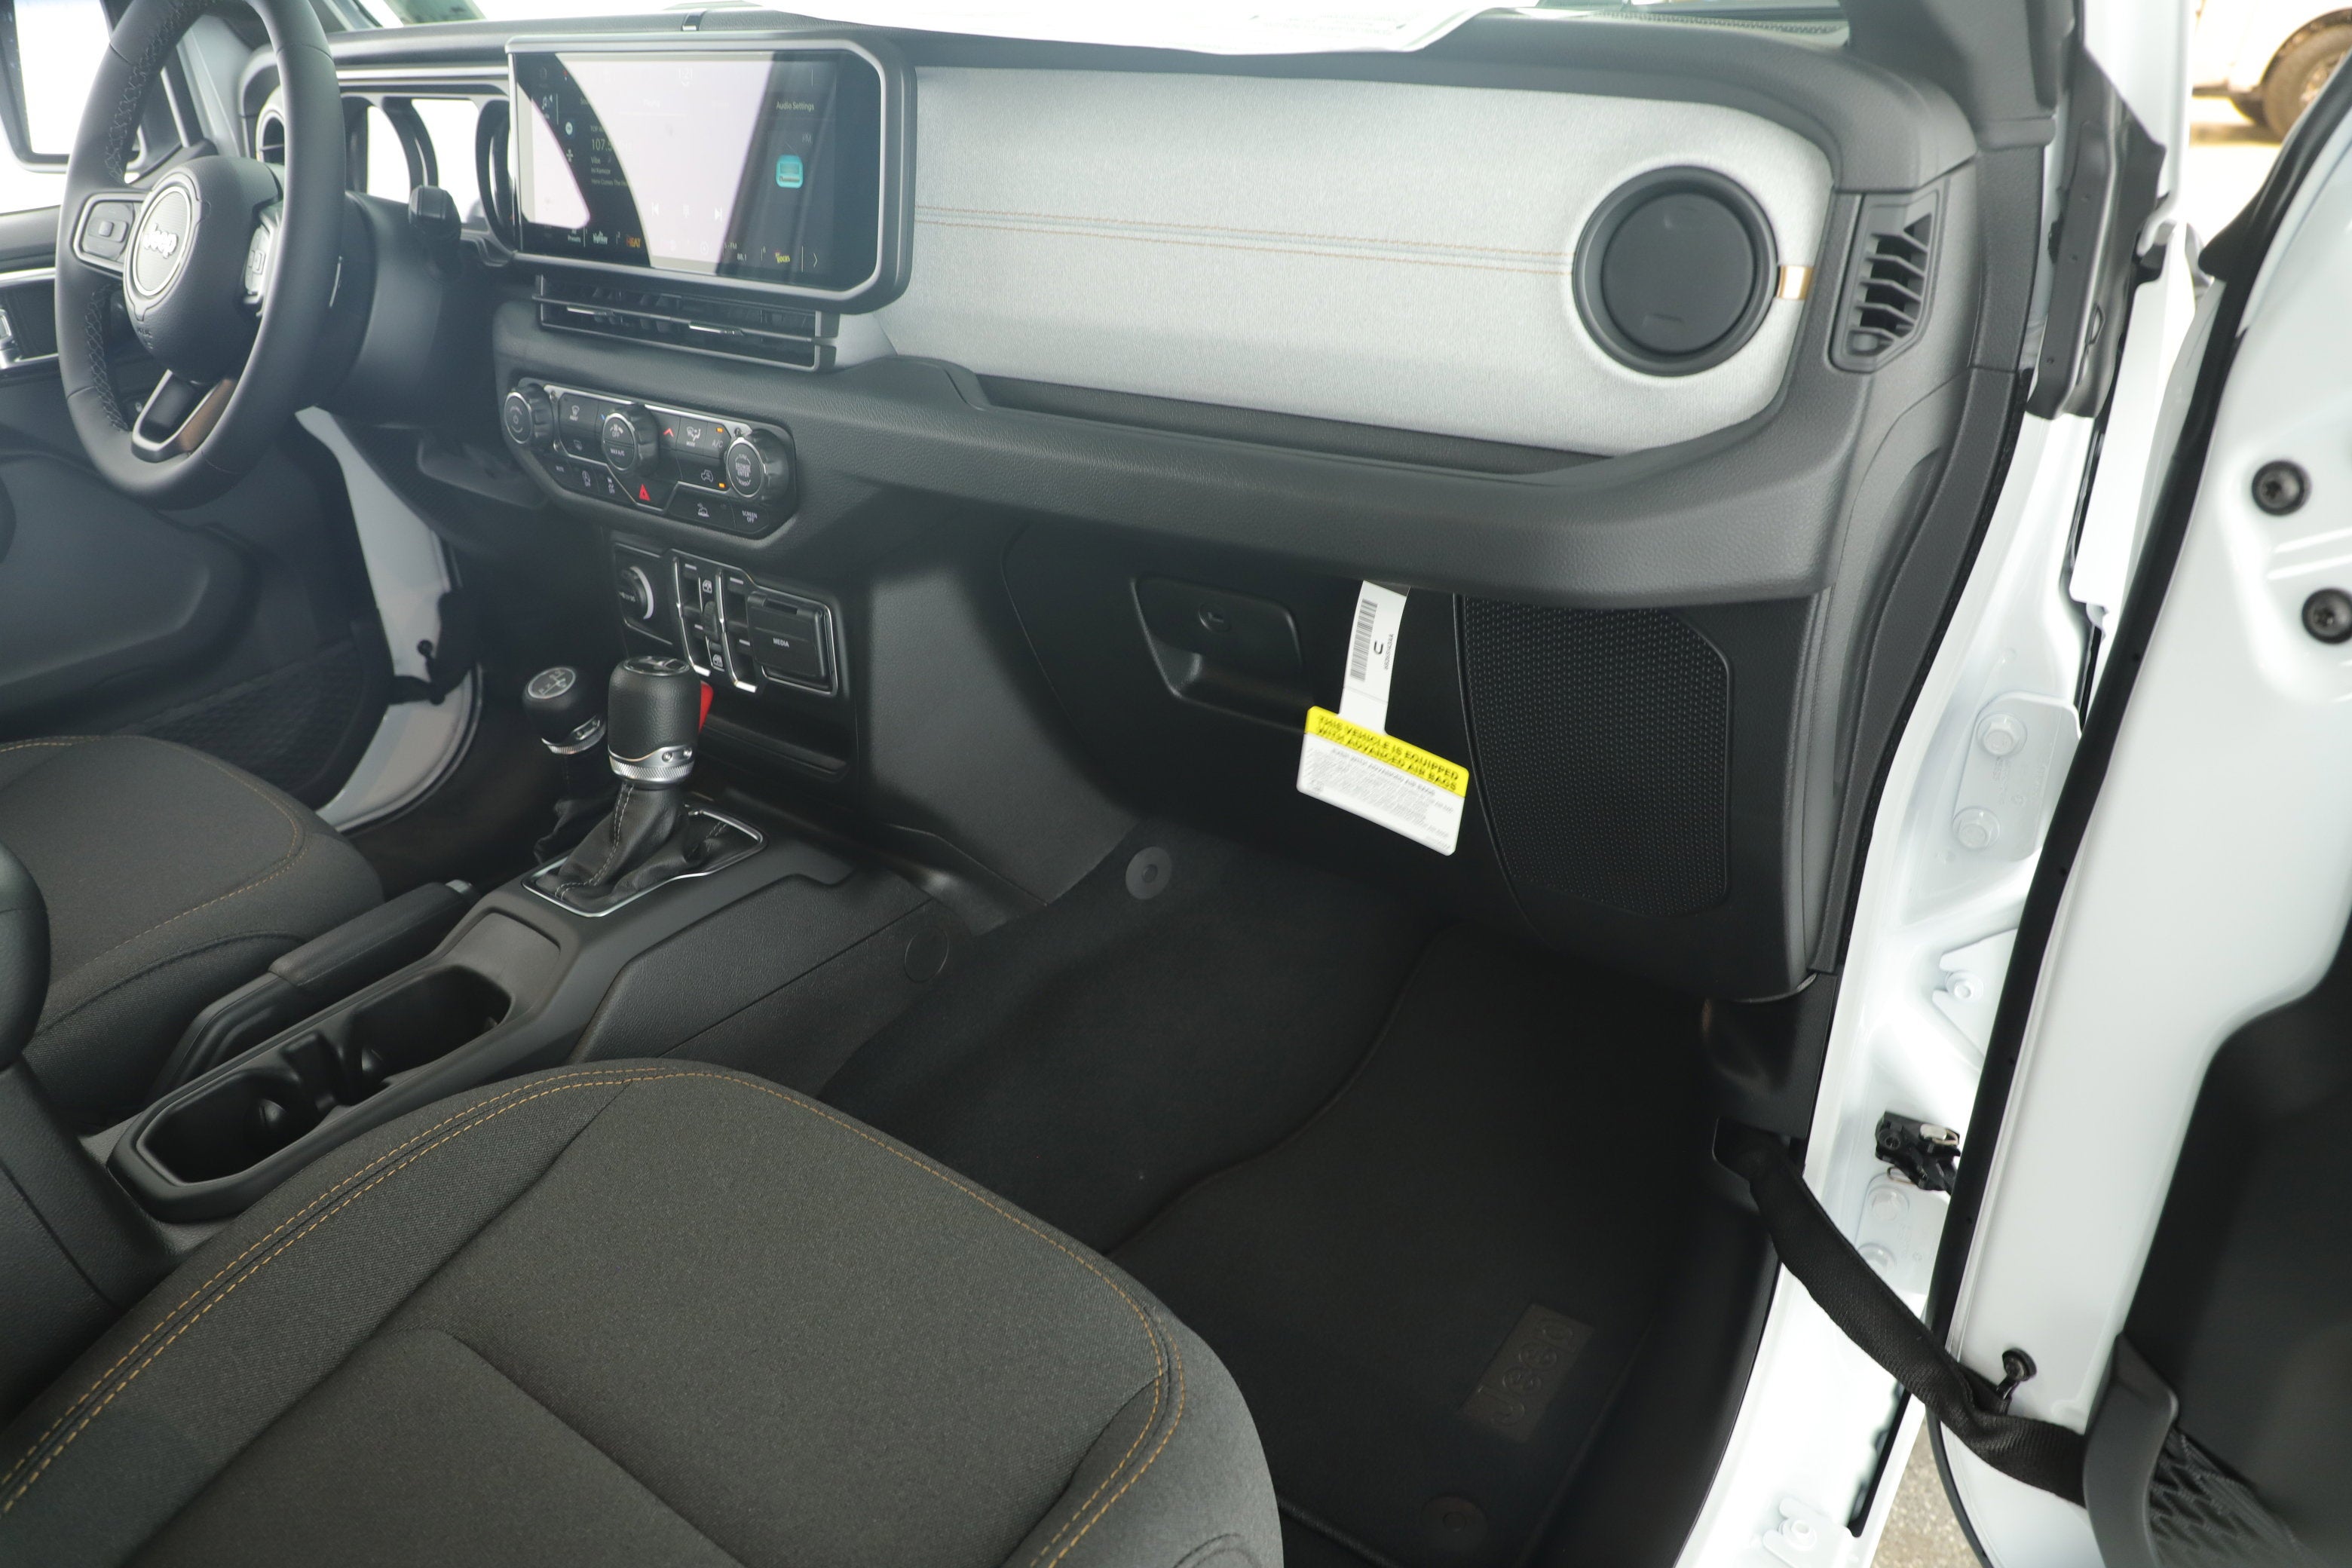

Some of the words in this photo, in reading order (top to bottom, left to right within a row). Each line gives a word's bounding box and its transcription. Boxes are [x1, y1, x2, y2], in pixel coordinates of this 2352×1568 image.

[776, 101, 792, 110] Audio
[793, 101, 814, 112] Settings
[802, 133, 812, 143] FM
[143, 222, 179, 259] Jeep
[568, 234, 581, 243] Presets
[626, 237, 641, 248] HEAT
[712, 439, 724, 448] A/C
[742, 510, 758, 519] SCREEN
[773, 637, 790, 648] MEDIA
[1374, 641, 1384, 655] U
[1318, 715, 1343, 731] THIS
[1346, 724, 1389, 749] VEHICLE
[1391, 743, 1403, 754] IS
[1404, 749, 1459, 781] EQUIPPED
[1346, 737, 1405, 767] ADVANCED
[1407, 763, 1426, 778] AIR
[1428, 773, 1457, 792] BAGS
